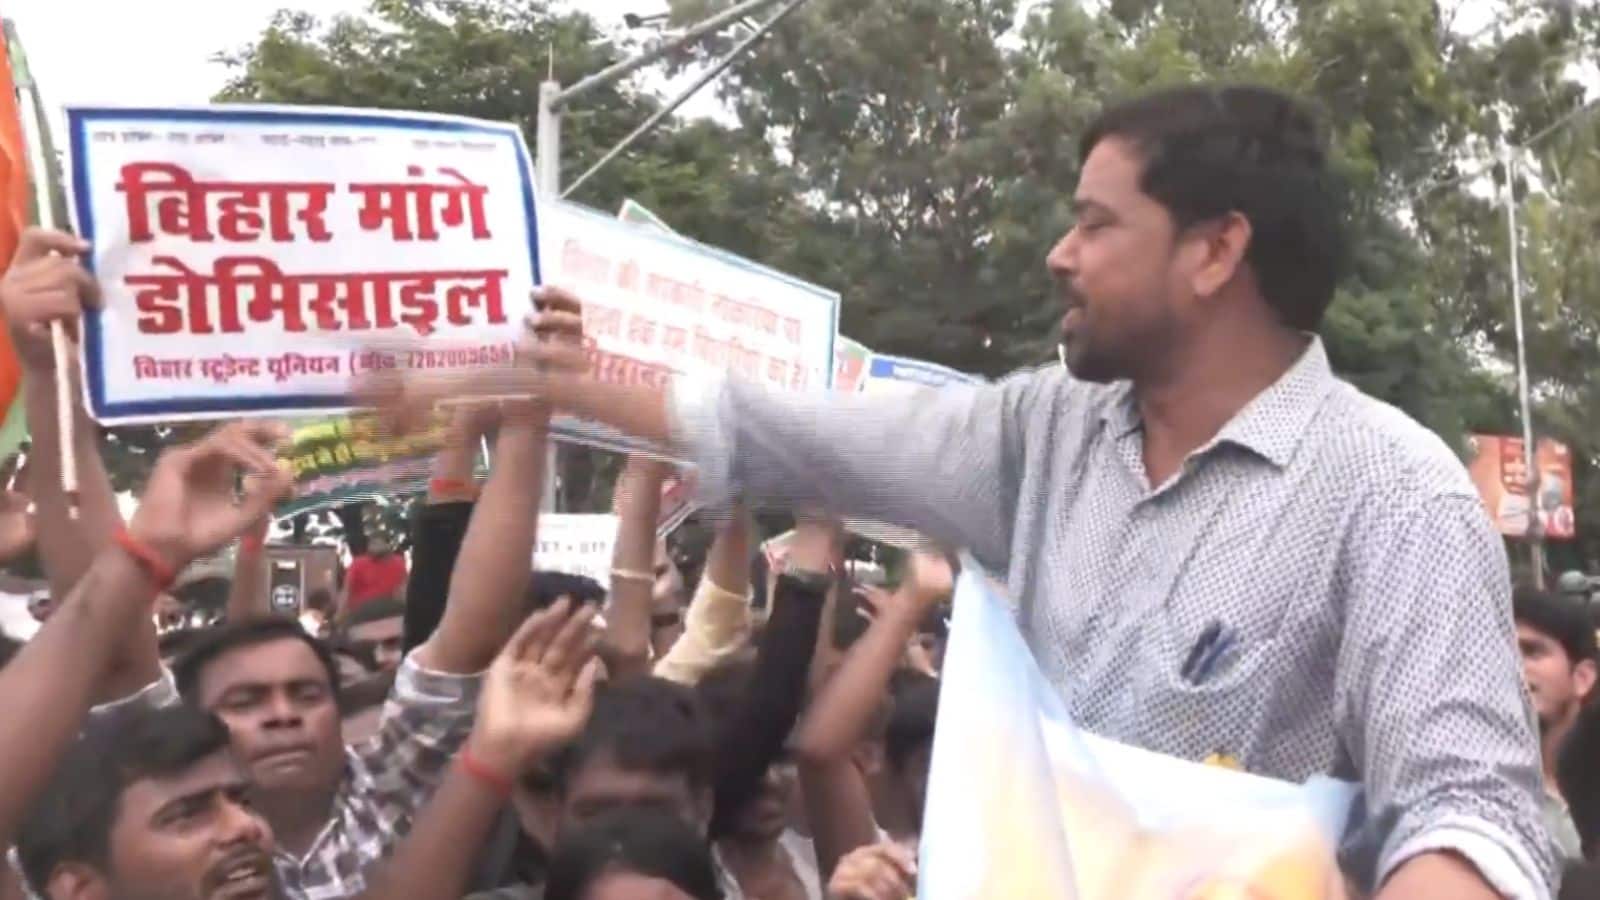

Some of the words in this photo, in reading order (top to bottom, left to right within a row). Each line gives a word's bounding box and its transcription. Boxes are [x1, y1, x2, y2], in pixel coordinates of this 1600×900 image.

[115, 162, 334, 241] बिहार
[349, 165, 491, 240] मांगे
[124, 256, 508, 336] डोमिसाइल
[133, 355, 192, 379] बिहार
